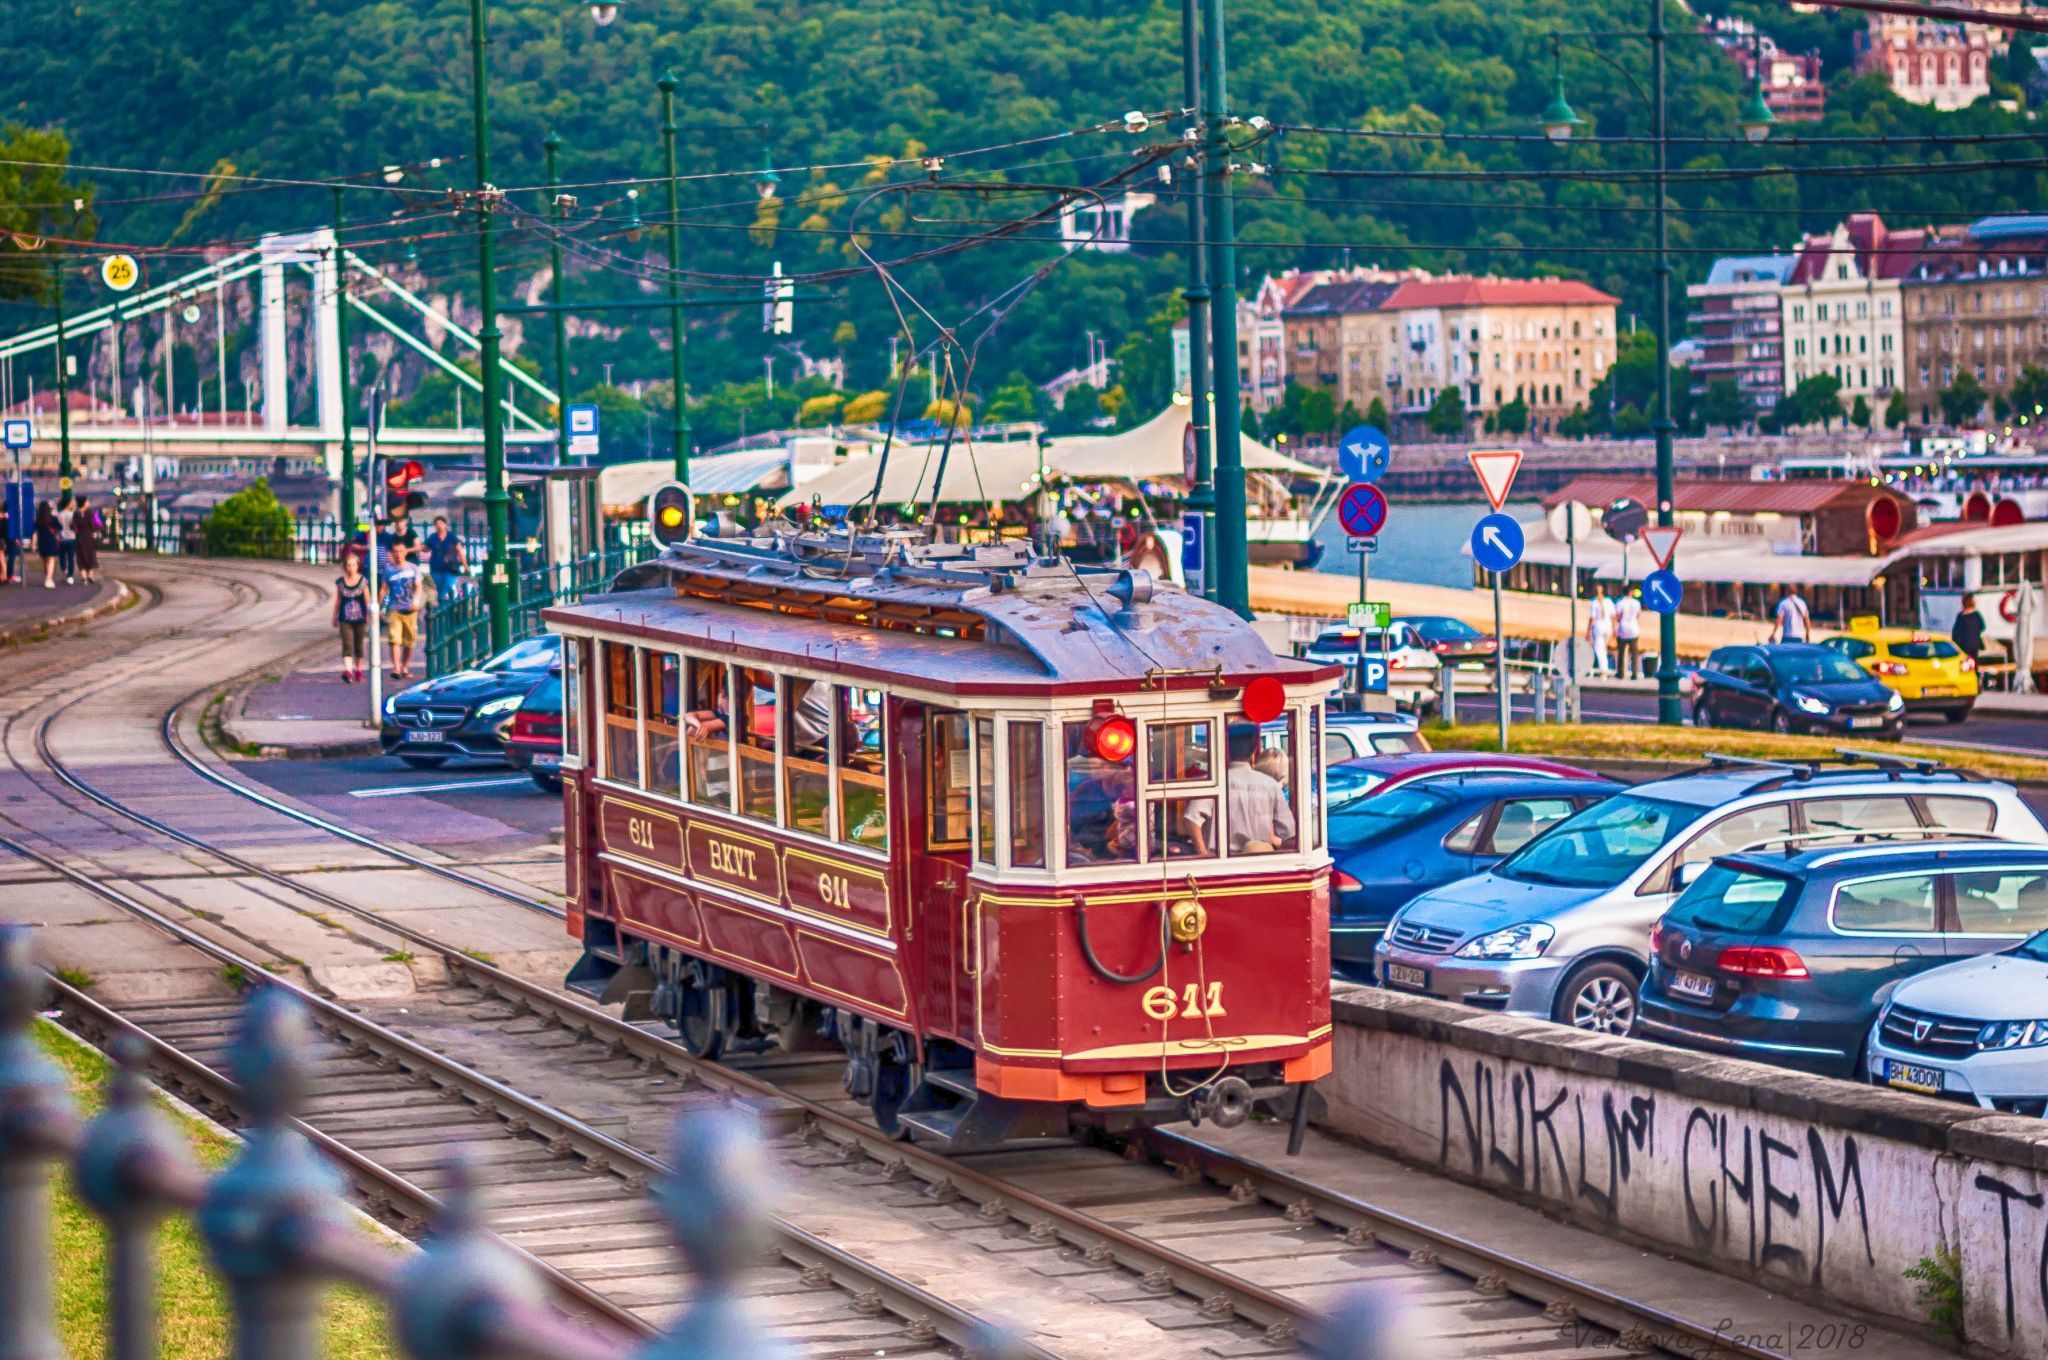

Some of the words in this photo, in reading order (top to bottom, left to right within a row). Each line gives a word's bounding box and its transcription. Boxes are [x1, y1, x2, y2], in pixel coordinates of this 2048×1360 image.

[112, 264, 131, 280] 25
[1367, 663, 1385, 687] P
[628, 817, 654, 850] 611
[818, 872, 850, 909] 611
[1142, 981, 1228, 1021] 611
[1683, 1106, 1875, 1289] CHEM
[1974, 1174, 2048, 1341] T
